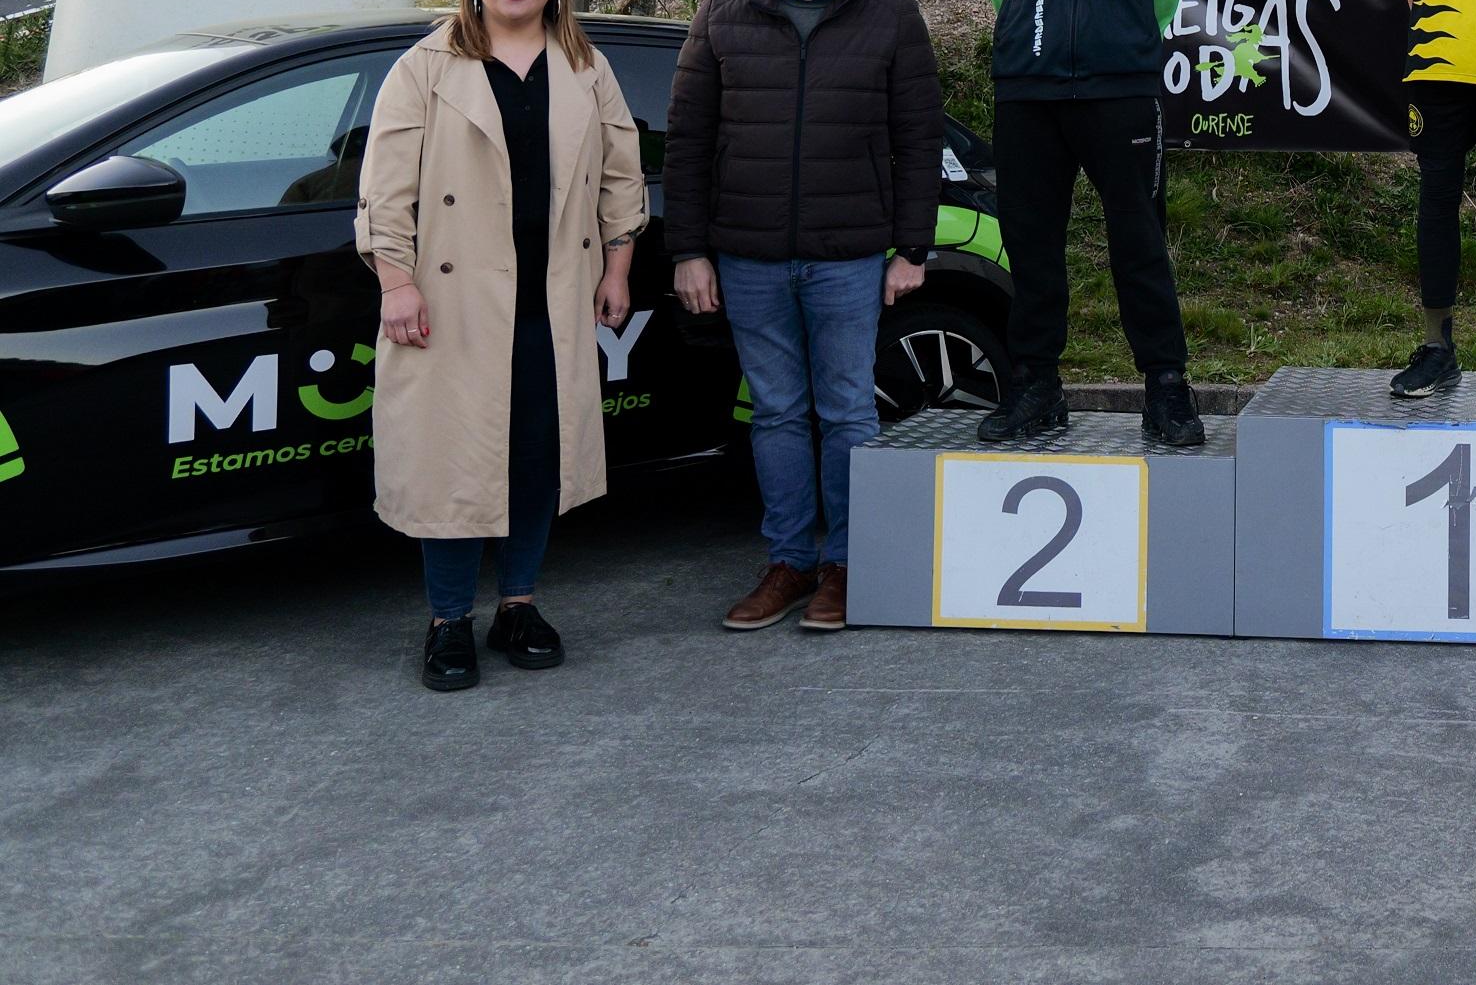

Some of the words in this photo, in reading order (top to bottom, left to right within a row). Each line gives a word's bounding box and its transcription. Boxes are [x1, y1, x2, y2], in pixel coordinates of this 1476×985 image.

[171, 444, 311, 479] Estamos
[601, 392, 651, 416] ejos
[997, 476, 1083, 608] 2
[1405, 443, 1472, 620] 1
